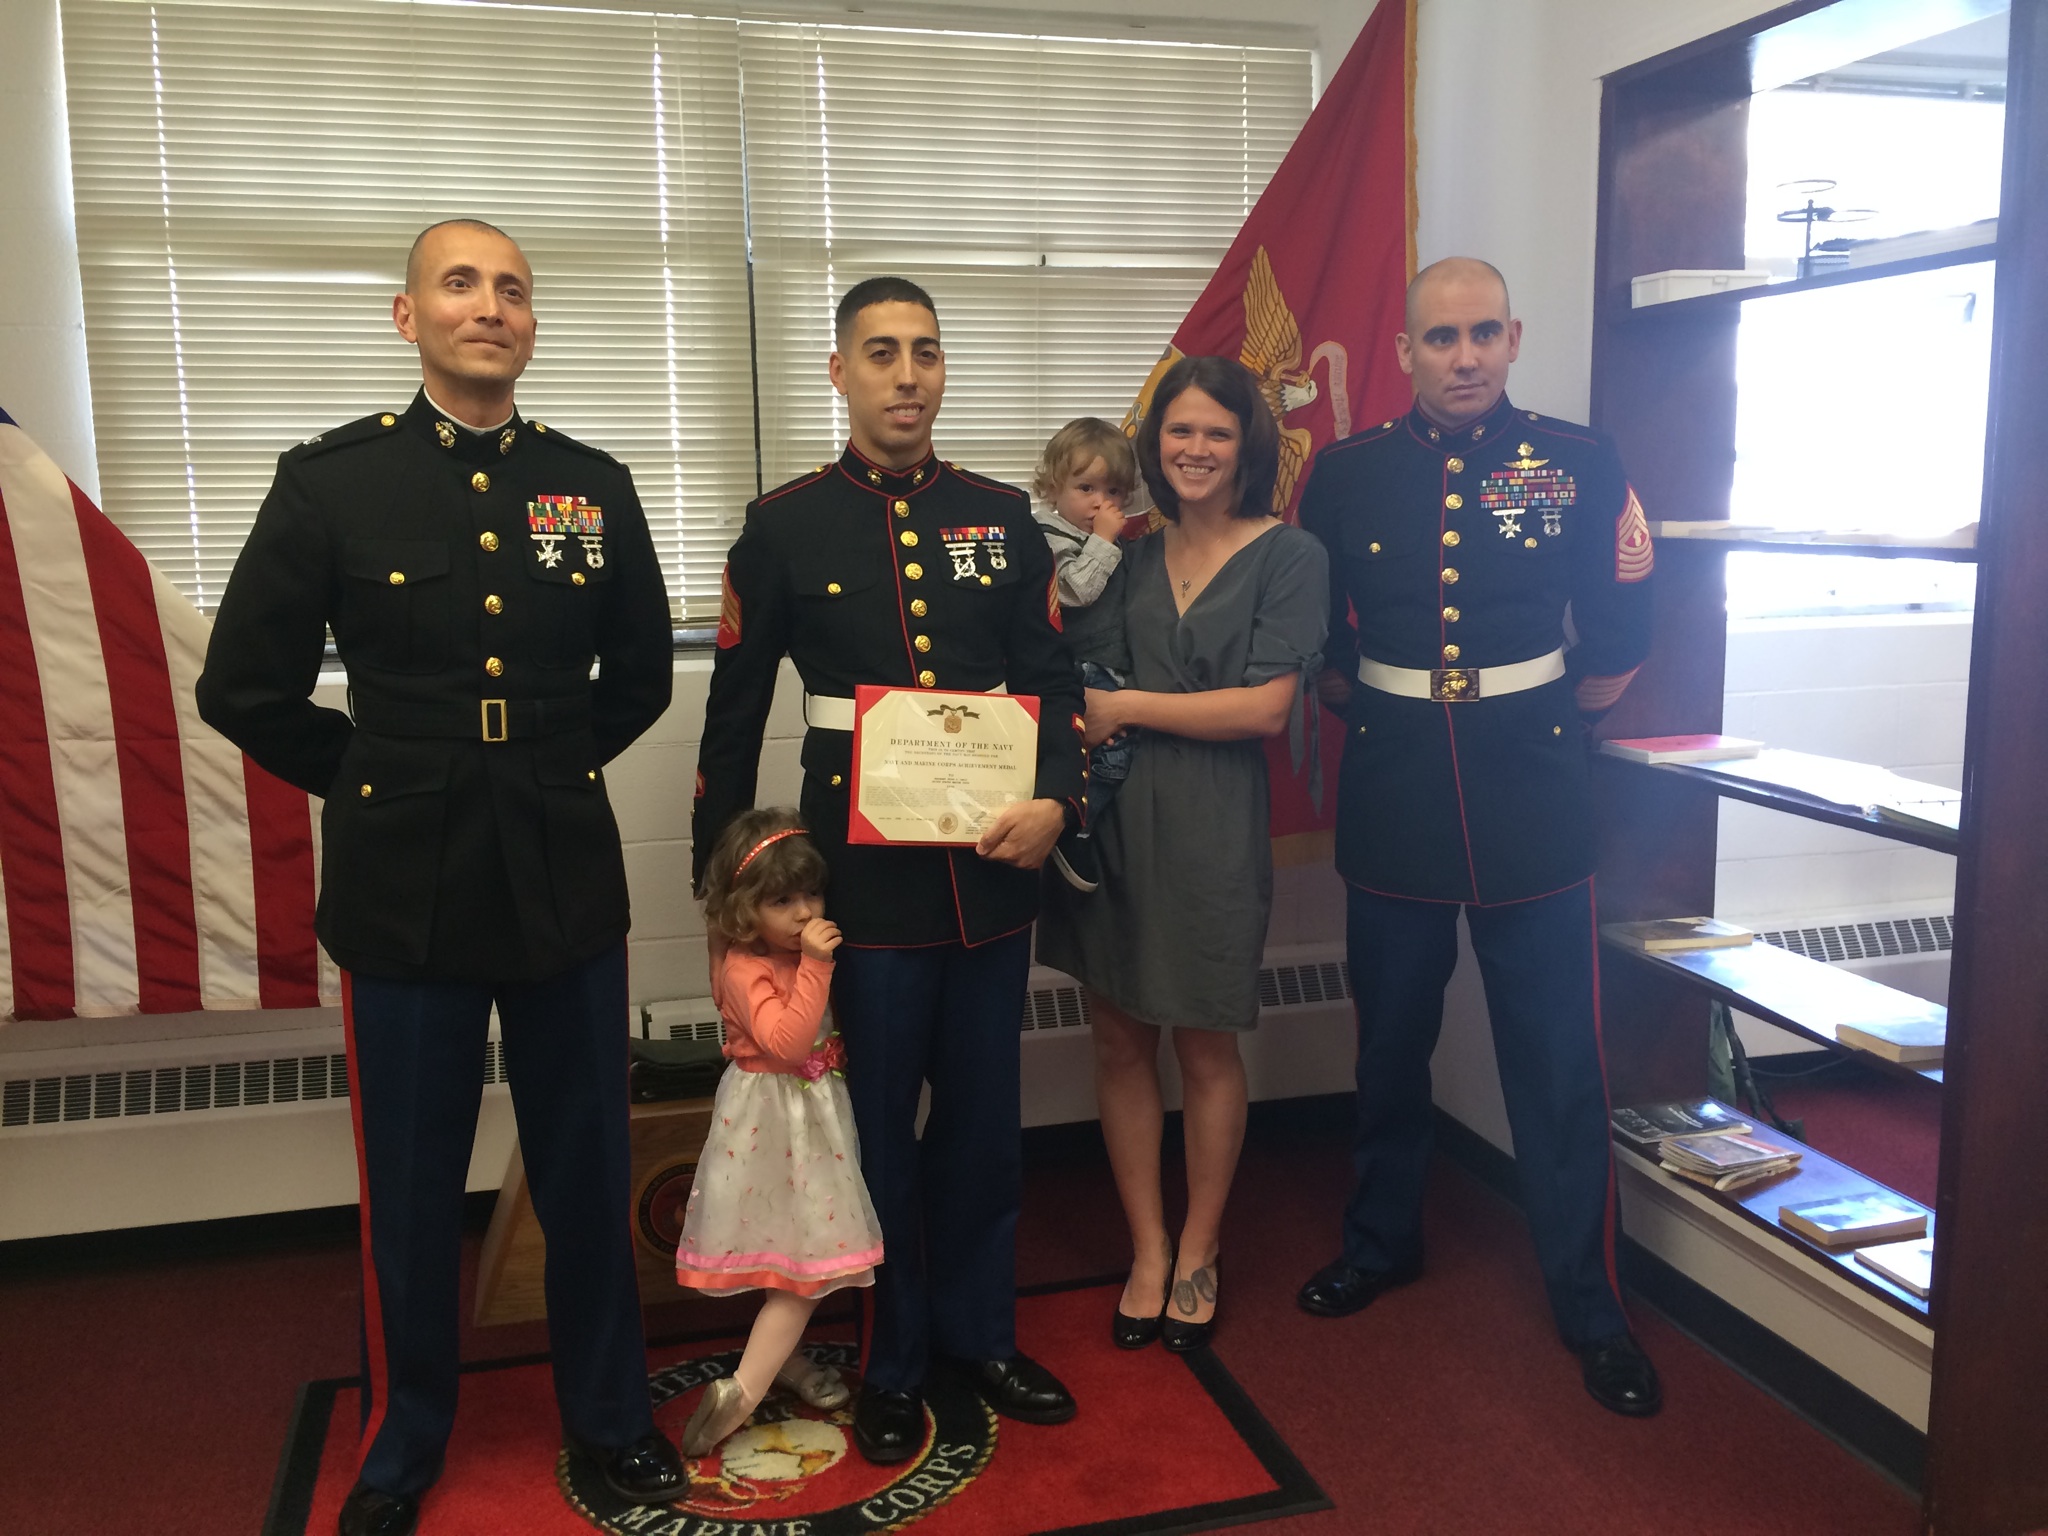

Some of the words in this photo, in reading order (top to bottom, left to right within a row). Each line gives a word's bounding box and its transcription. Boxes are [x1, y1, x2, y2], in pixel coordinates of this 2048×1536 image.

[890, 738, 951, 748] DEPARTMENT
[971, 742, 989, 750] THE
[992, 743, 1014, 751] NAVY
[860, 1441, 977, 1523] CORPS
